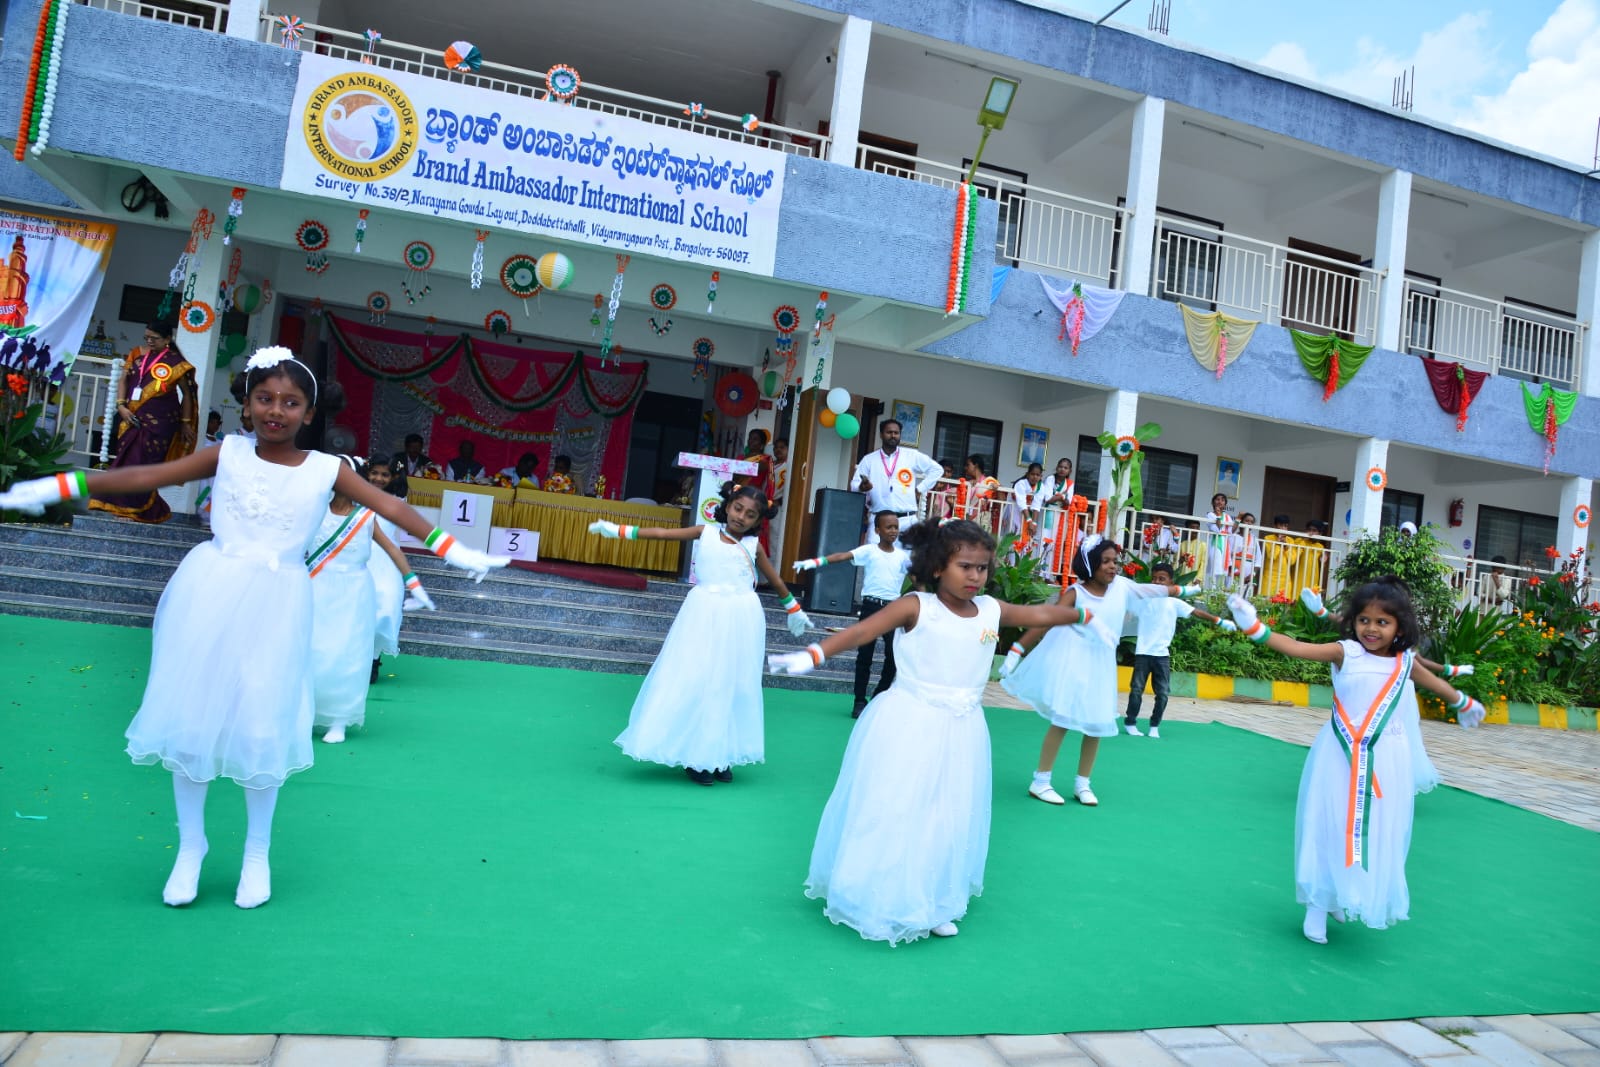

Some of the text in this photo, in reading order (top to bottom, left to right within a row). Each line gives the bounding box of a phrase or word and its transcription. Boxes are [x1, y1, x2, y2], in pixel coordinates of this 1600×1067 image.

[311, 76, 414, 126] BRAND AMBASSADOR
[308, 123, 413, 178] INTERNATIONAL SCHOOL
[503, 123, 613, 168] ಅಂಬಾಸಿಡರ್
[315, 174, 360, 199] Survey
[411, 190, 457, 215] Narayana
[458, 197, 485, 216] Gowda
[591, 223, 653, 247] Vidyaranyapura
[412, 149, 748, 238] Brand Ambassador International School
[0, 220, 71, 238] INTERNATIONAL
[457, 499, 470, 522] 1
[508, 533, 520, 551] 3
